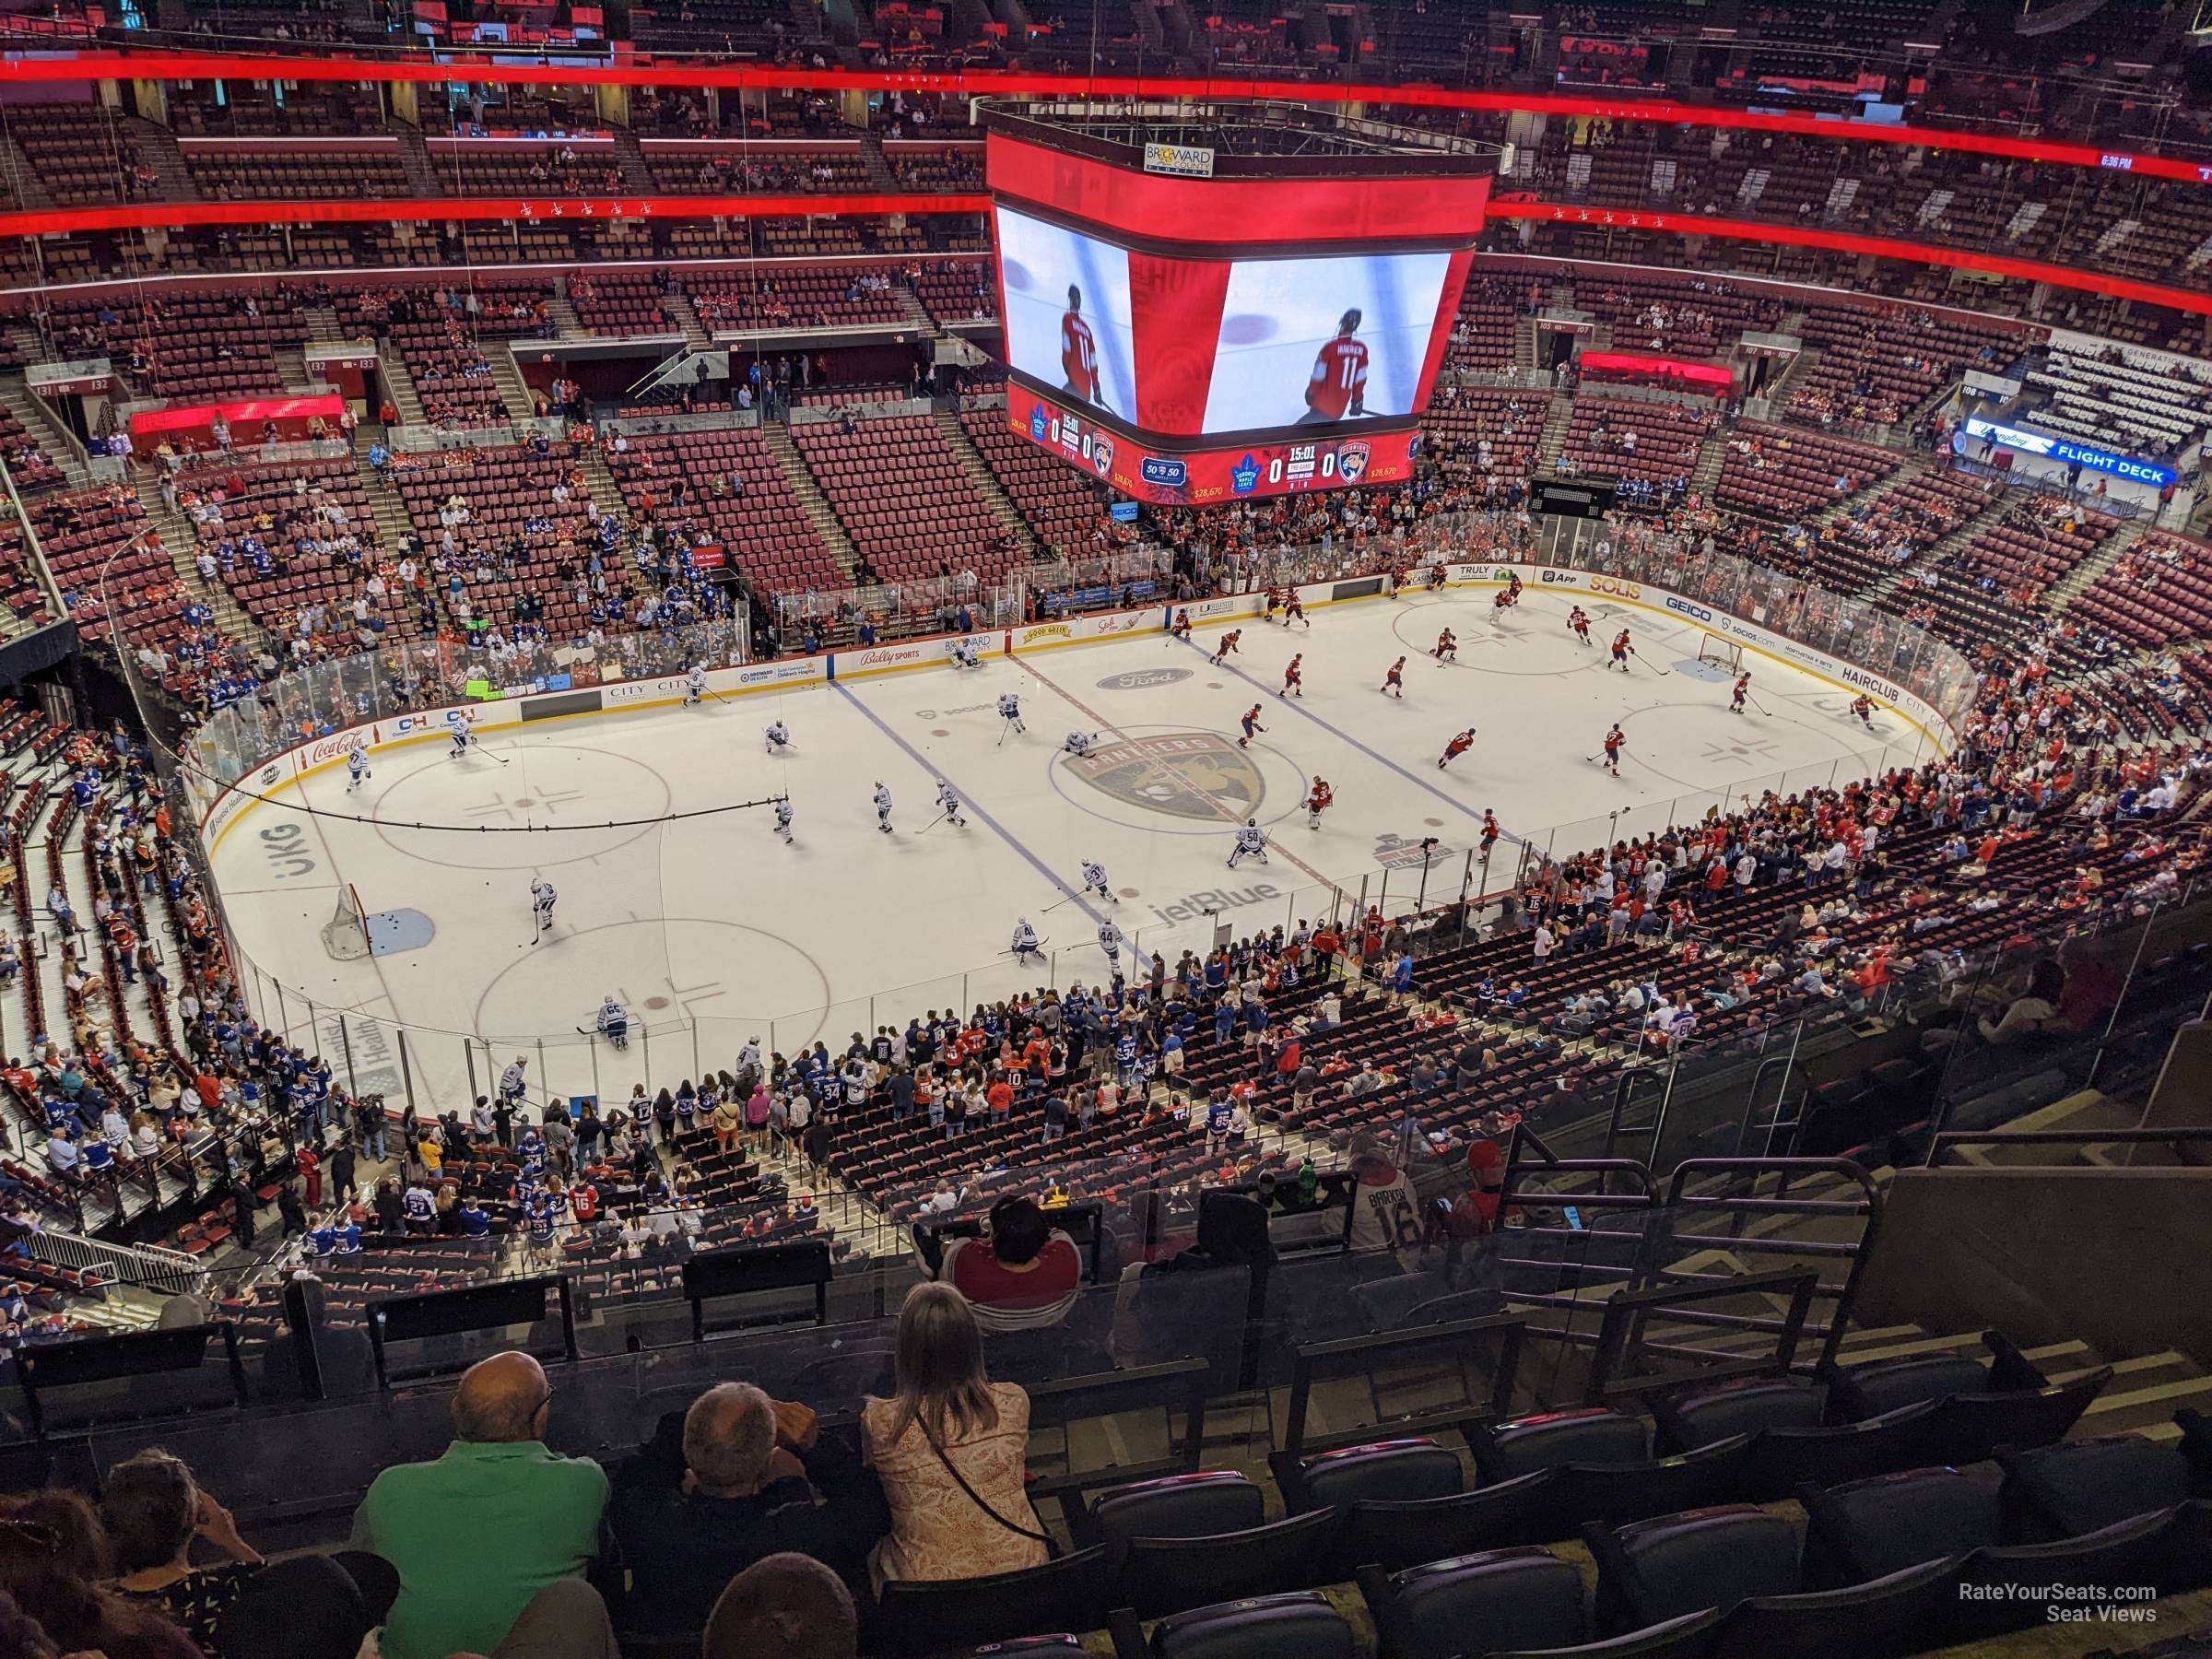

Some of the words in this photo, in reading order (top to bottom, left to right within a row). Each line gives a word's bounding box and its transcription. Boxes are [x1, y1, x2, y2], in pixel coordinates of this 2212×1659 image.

[1147, 147, 1211, 163] BROWARD
[1174, 161, 1210, 170] COUNTY
[2101, 156, 2119, 167] 6:36
[2120, 158, 2132, 170] PM
[1147, 165, 1207, 175] FLORIDA
[1577, 325, 1589, 334] 107
[312, 362, 325, 371] 132
[359, 360, 373, 369] 133
[1341, 357, 1359, 390] 11
[91, 380, 109, 389] 132
[1961, 386, 1976, 396] 108
[1063, 414, 1078, 433] 15:01
[1052, 418, 1059, 443] 0
[1083, 435, 1090, 460] 0
[1290, 445, 1315, 461] 15:01
[1147, 465, 1158, 475] 50
[1168, 466, 1180, 477] 50
[1269, 459, 1282, 484] 0
[1323, 453, 1335, 477] 0
[2056, 446, 2115, 470] FLIGHT
[2118, 461, 2165, 484] DECK
[1113, 473, 1133, 488] $28,670
[1194, 487, 1223, 499] $28,670
[1461, 566, 1490, 575] TRULY
[1590, 575, 1641, 599] SOLIS
[1666, 597, 1712, 622] GEICO
[1029, 629, 1046, 640] GOOD
[1048, 626, 1066, 636] GREEK
[861, 651, 894, 666] Bally
[895, 650, 920, 661] SPORTS
[658, 679, 689, 691] CITY
[1119, 671, 1175, 688] Ford
[1841, 667, 1900, 701] HAIRCLUB
[610, 685, 645, 698] CITY
[1906, 697, 1926, 714] CITY
[1084, 738, 1211, 771] PANTHERS
[1247, 832, 1259, 842] 50
[1091, 866, 1103, 879] 37
[1147, 883, 1282, 928] jetBlue
[1530, 899, 1540, 909] 16
[1100, 931, 1112, 943] 44
[606, 1005, 620, 1015] 65
[354, 1019, 391, 1065] Health
[1123, 1048, 1135, 1059] 34
[1008, 1073, 1021, 1086] 10
[308, 1081, 320, 1093] 91
[825, 1088, 840, 1100] 34
[638, 1108, 651, 1120] 17
[410, 1201, 426, 1213] 27
[575, 1198, 589, 1211] 16
